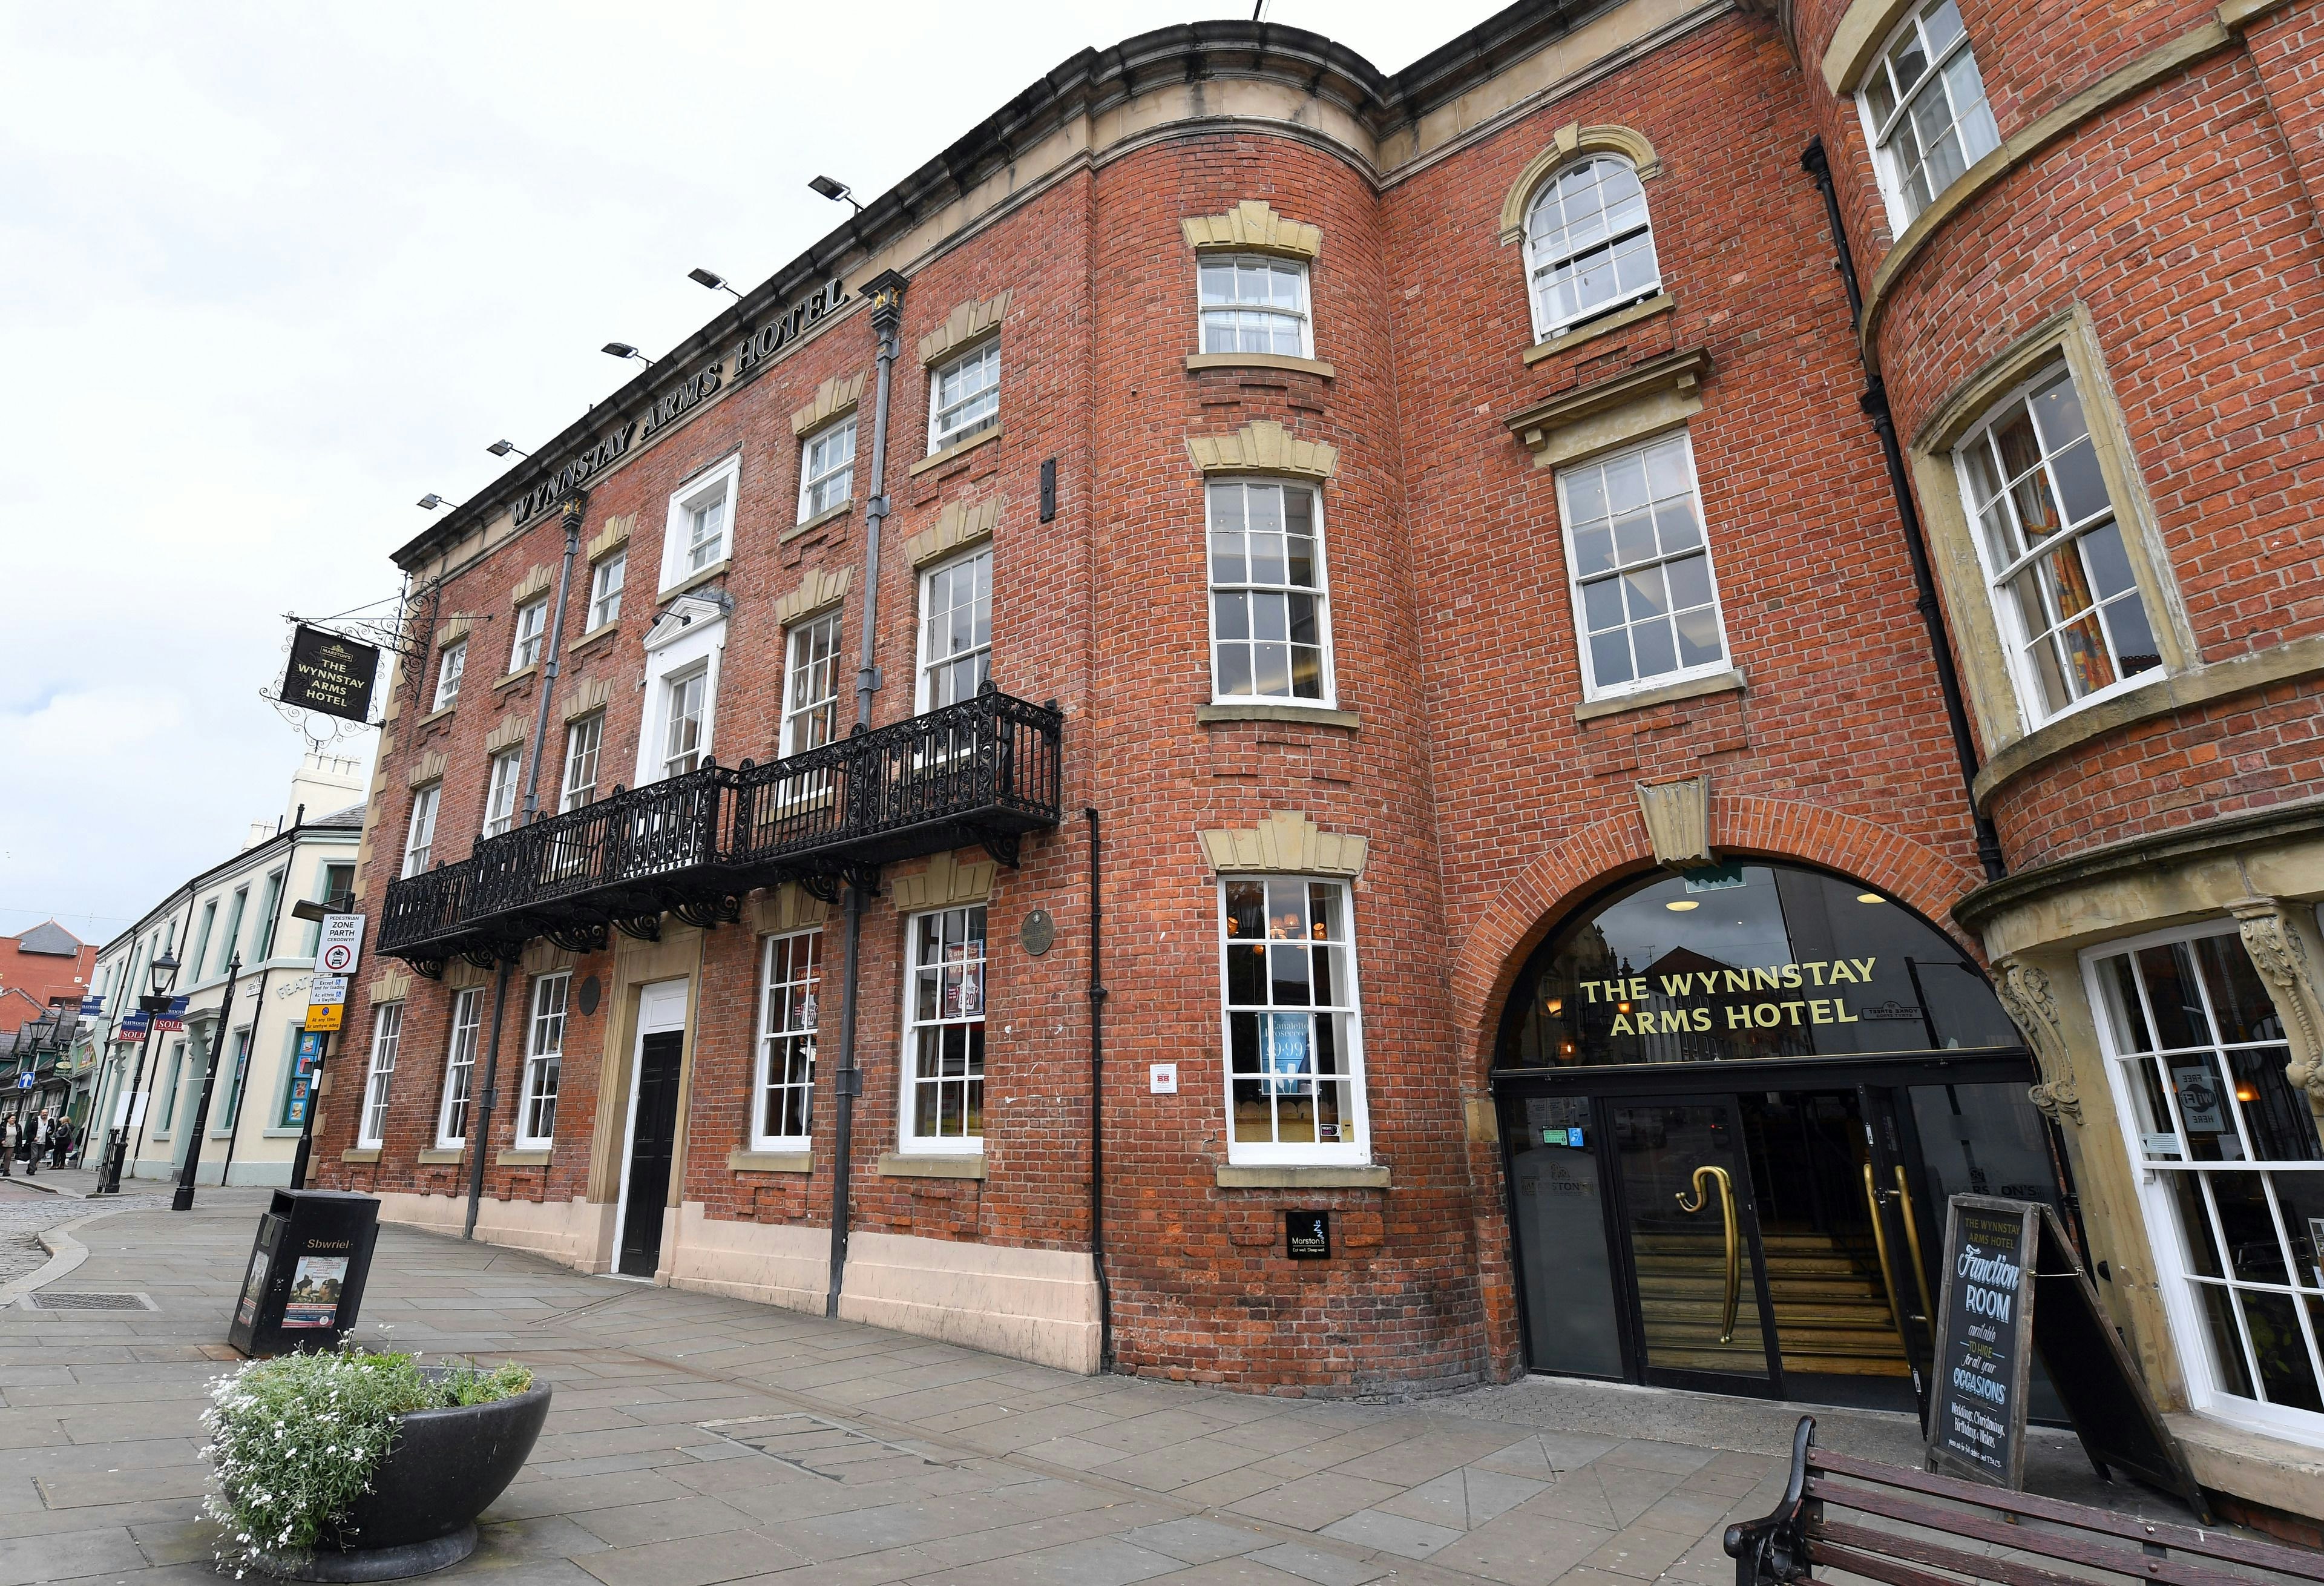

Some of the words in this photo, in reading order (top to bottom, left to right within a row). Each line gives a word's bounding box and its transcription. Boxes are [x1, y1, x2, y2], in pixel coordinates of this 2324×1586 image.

[511, 421, 636, 525] WYNNSTAY
[640, 362, 723, 441] ARMS
[732, 278, 850, 378] HOTEL
[322, 648, 351, 660] MARSTON'S
[298, 663, 365, 689] WYNNSTAY
[322, 659, 347, 673] THE
[306, 689, 347, 707] HOTEL
[311, 680, 347, 696] ARMS
[1580, 976, 1650, 1003] THE
[1660, 957, 1876, 998] WYNNSTAY
[1610, 1007, 1712, 1036] ARMS
[1724, 998, 1859, 1029] HOTEL
[122, 1030, 146, 1039] SOLD
[1965, 1217, 1978, 1229] THE
[1981, 1220, 2020, 1235] WYNNSTAY
[307, 1239, 349, 1249] Sbwriel
[1969, 1232, 1989, 1245] ARMS
[1991, 1236, 2014, 1249] HOTEL
[1958, 1244, 2020, 1291] Function
[1966, 1284, 2011, 1324] ROOM
[1968, 1323, 1996, 1343] available
[1969, 1340, 1977, 1353] TO
[1977, 1344, 1992, 1358] HIRE
[1961, 1354, 1972, 1366] for
[1972, 1356, 1982, 1369] all
[1980, 1360, 1997, 1374] your
[1953, 1367, 2006, 1404] OCCASIONS
[1954, 1417, 1977, 1443] Birthdays
[1979, 1429, 1995, 1449] Wakes
